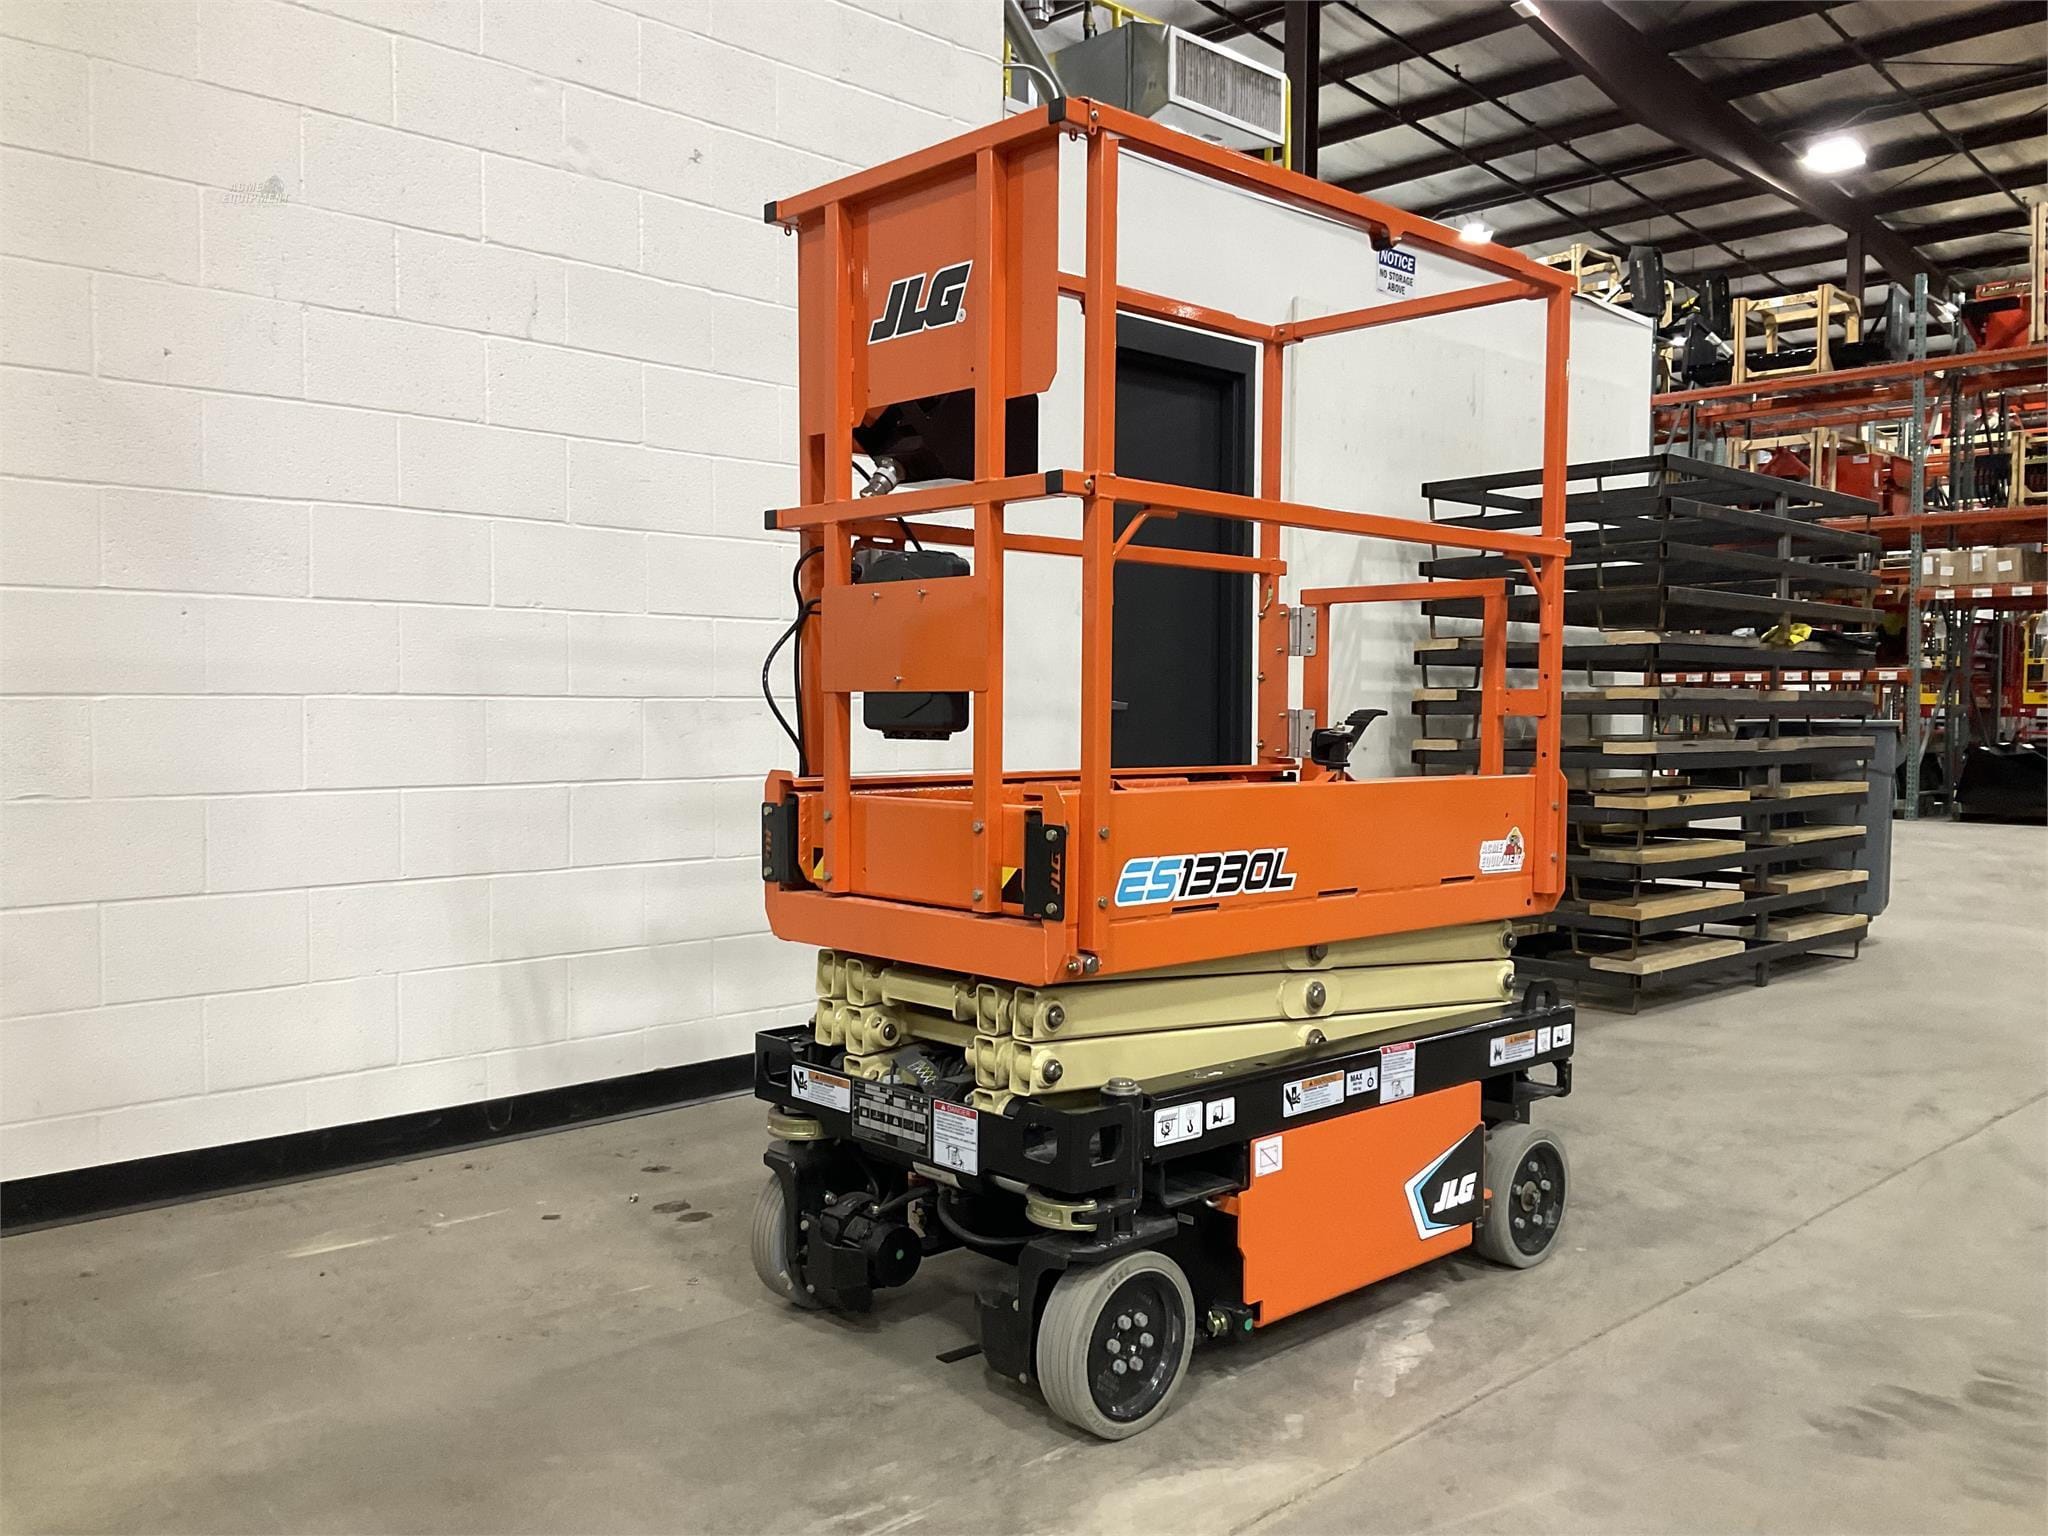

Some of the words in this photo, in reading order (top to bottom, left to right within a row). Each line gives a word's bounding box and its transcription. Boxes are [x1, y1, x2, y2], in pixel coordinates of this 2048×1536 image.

[1380, 250, 1415, 272] NOTICE
[1379, 269, 1388, 279] NO
[1388, 271, 1414, 287] STORAGE
[1387, 281, 1406, 296] ABOVE
[868, 260, 973, 345] JLG
[1049, 851, 1062, 896] JLG
[1116, 850, 1296, 905] ES1330L
[1350, 1072, 1363, 1082] MAX
[946, 1105, 971, 1117] DANGER
[1431, 1171, 1478, 1214] JLG
